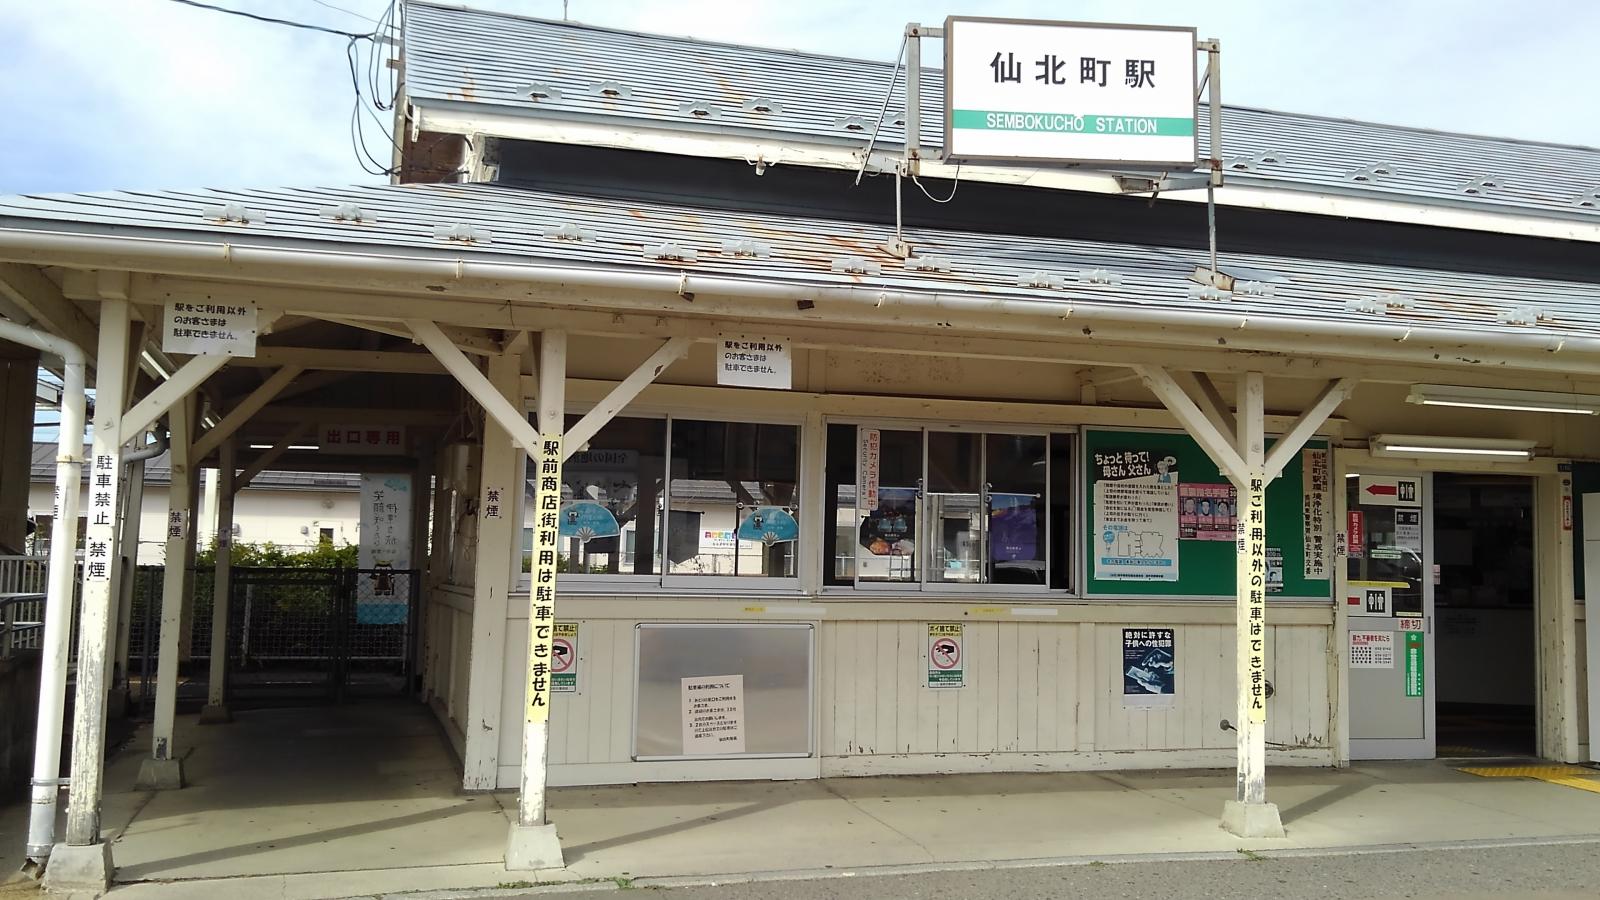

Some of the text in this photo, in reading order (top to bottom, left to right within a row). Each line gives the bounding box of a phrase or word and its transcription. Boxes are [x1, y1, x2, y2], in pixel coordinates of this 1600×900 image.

[990, 51, 1157, 89] 仙北町駅
[1095, 117, 1158, 134] STATION
[174, 302, 247, 316] 駅をご利用以外
[173, 315, 227, 327] のお客さまは
[724, 340, 783, 352] 駅をご利用以外
[724, 352, 767, 362] のお客さまは
[326, 429, 400, 445] 出口専用
[93, 454, 113, 525] 駐車禁止
[486, 490, 500, 517] 禁煙
[168, 511, 182, 538] 禁煙
[1336, 533, 1346, 557] 禁煙
[88, 541, 107, 578] 禁煙
[531, 440, 559, 707] 駅前商店街利用は駐車できません
[1250, 478, 1263, 709] 駅ご利用以外の駐車はできません
[1124, 631, 1171, 639] 絶対に許すな
[1124, 639, 1172, 648] 子供への性犯罪
